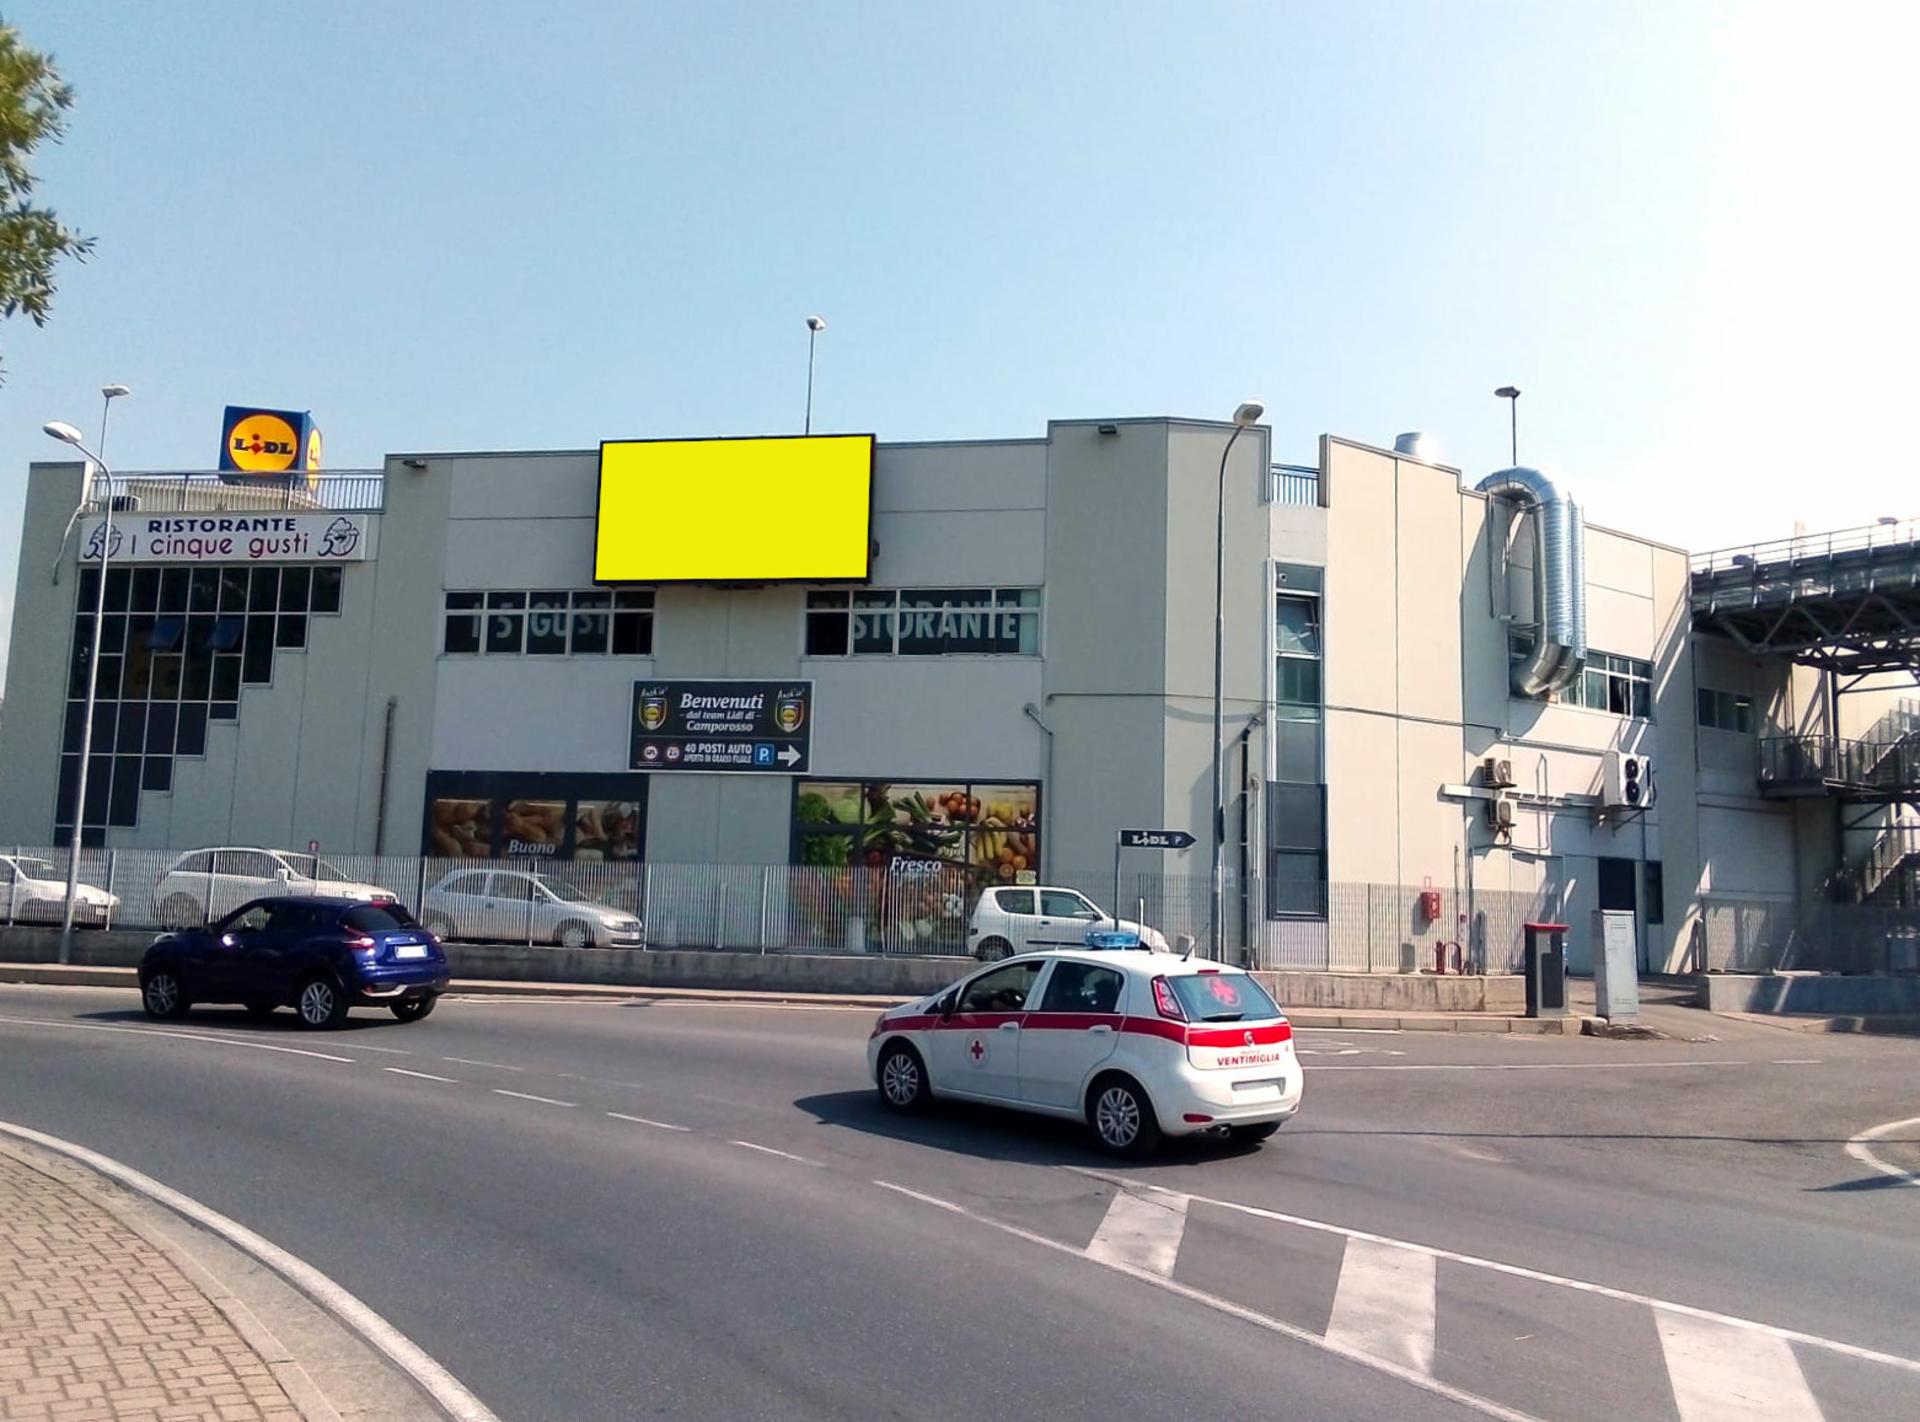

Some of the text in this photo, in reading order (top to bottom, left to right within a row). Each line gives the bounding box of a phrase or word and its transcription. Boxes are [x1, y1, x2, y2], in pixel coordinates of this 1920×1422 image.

[148, 518, 297, 533] RISTORANTE
[150, 535, 233, 559] cinque
[249, 533, 308, 558] gusti
[680, 693, 764, 709] Benvenuti
[686, 712, 755, 720] dal team Lidl di
[686, 720, 754, 733] Camporosso
[685, 744, 697, 753] 40
[699, 743, 725, 753] POSTI
[728, 744, 752, 754] AUTO
[508, 839, 556, 854] Buono
[890, 856, 942, 873] Fresco
[1217, 1053, 1280, 1066] VENTIMIGLIA
